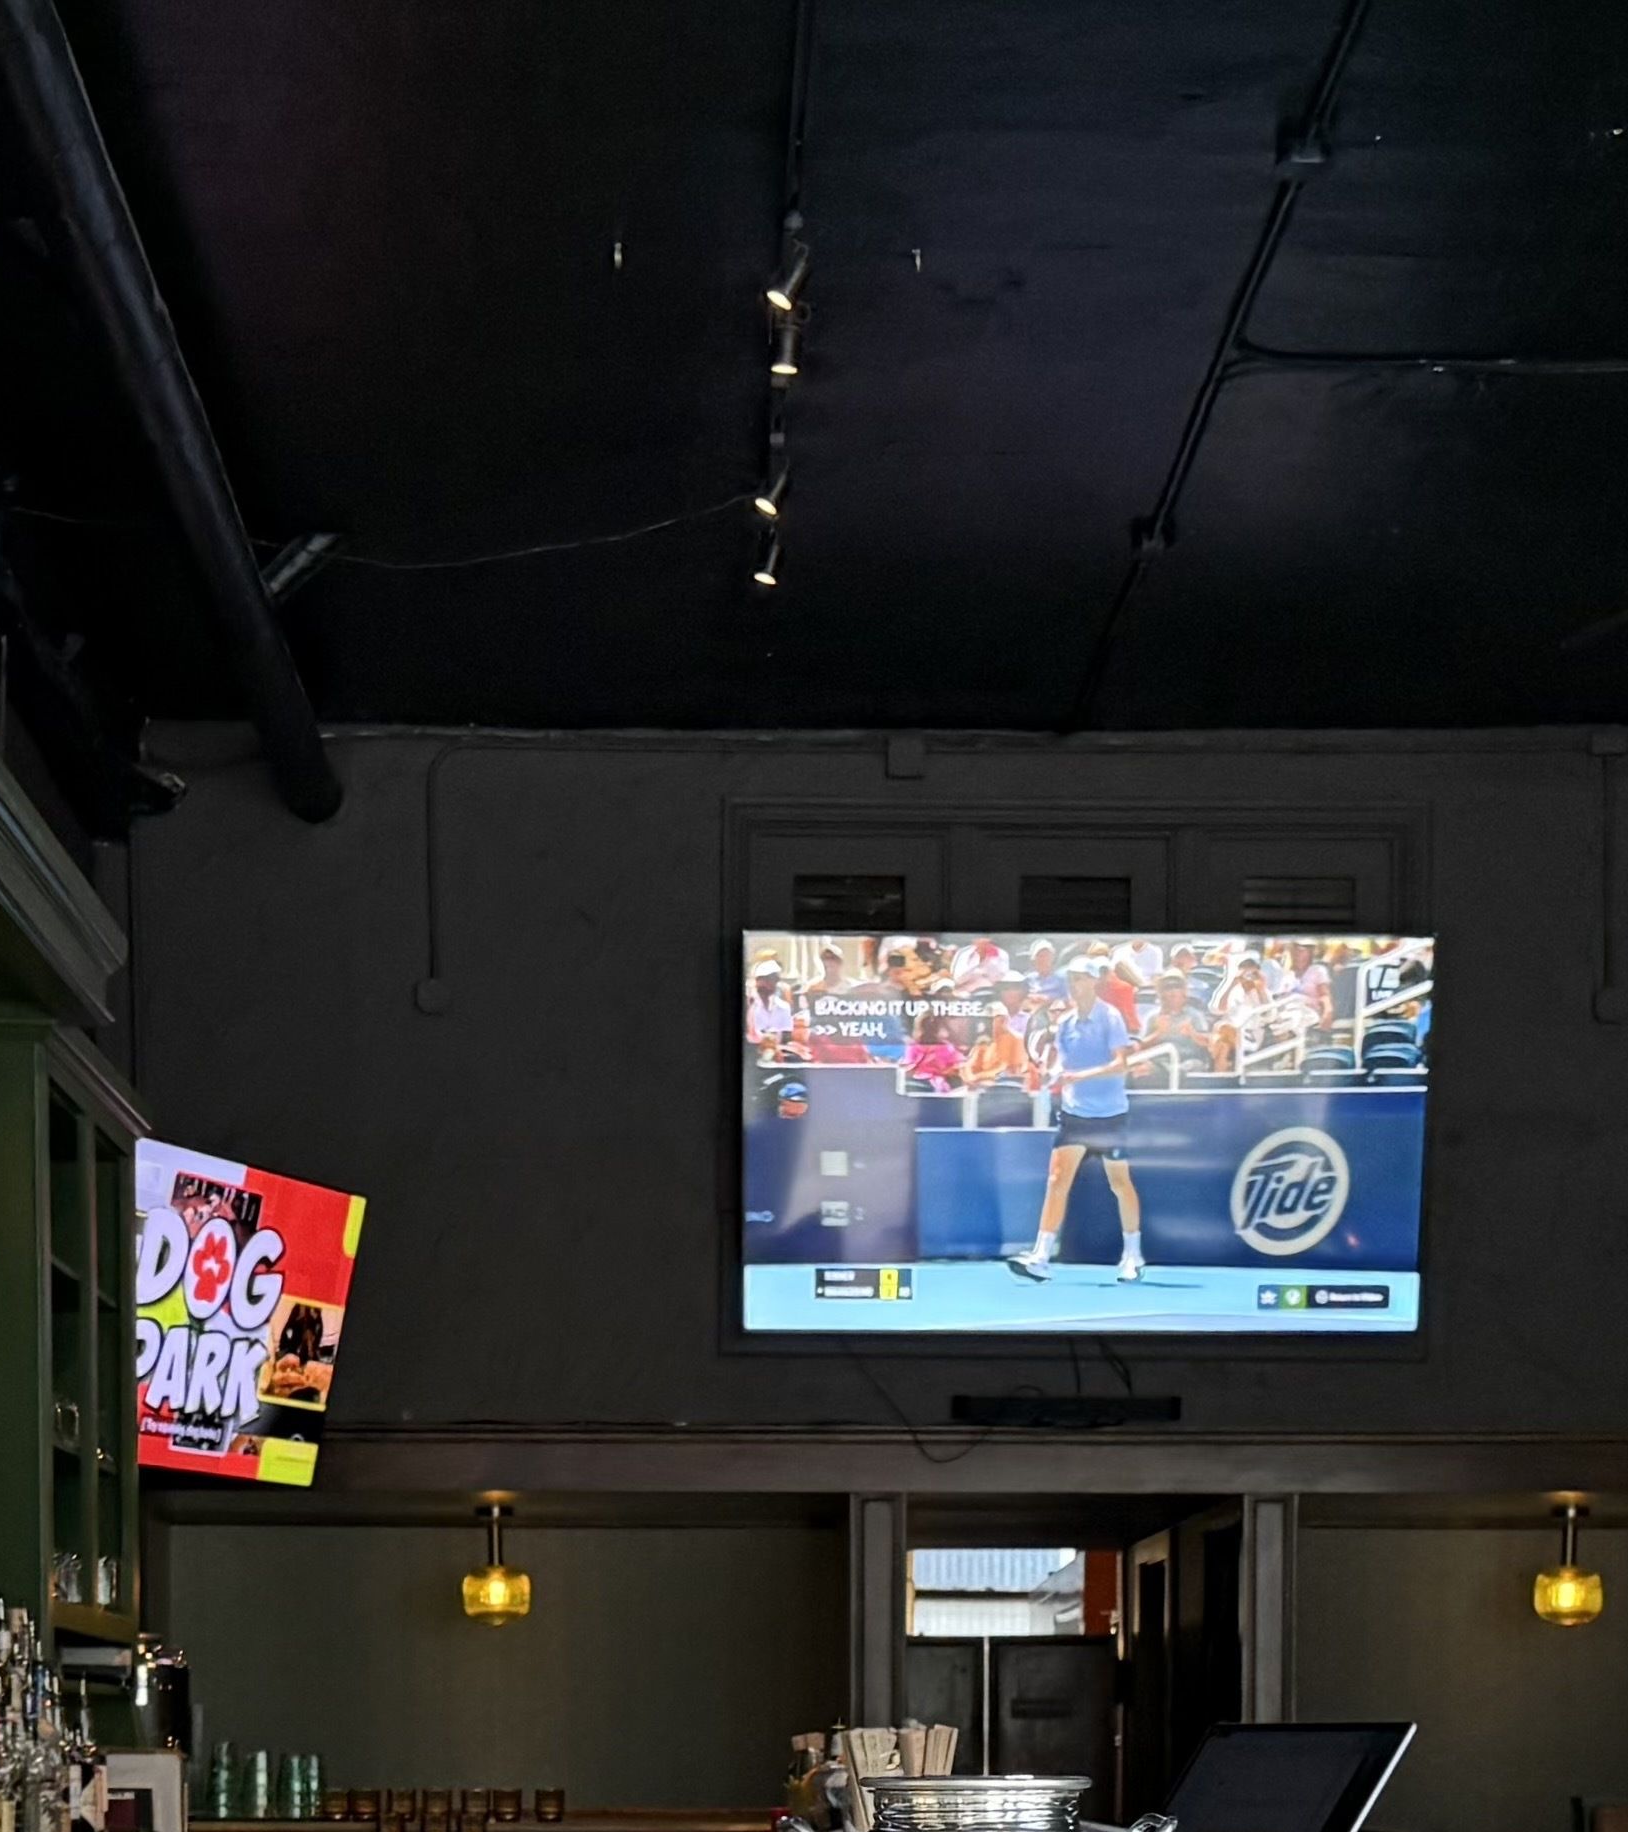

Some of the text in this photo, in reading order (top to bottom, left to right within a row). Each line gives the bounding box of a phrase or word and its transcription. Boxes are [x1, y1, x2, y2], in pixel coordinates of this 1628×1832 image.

[814, 999, 886, 1017] BACKING
[888, 1000, 905, 1016] IT
[905, 1000, 930, 1016] UP
[1235, 1153, 1339, 1233] Tide
[136, 1206, 285, 1331] DOG
